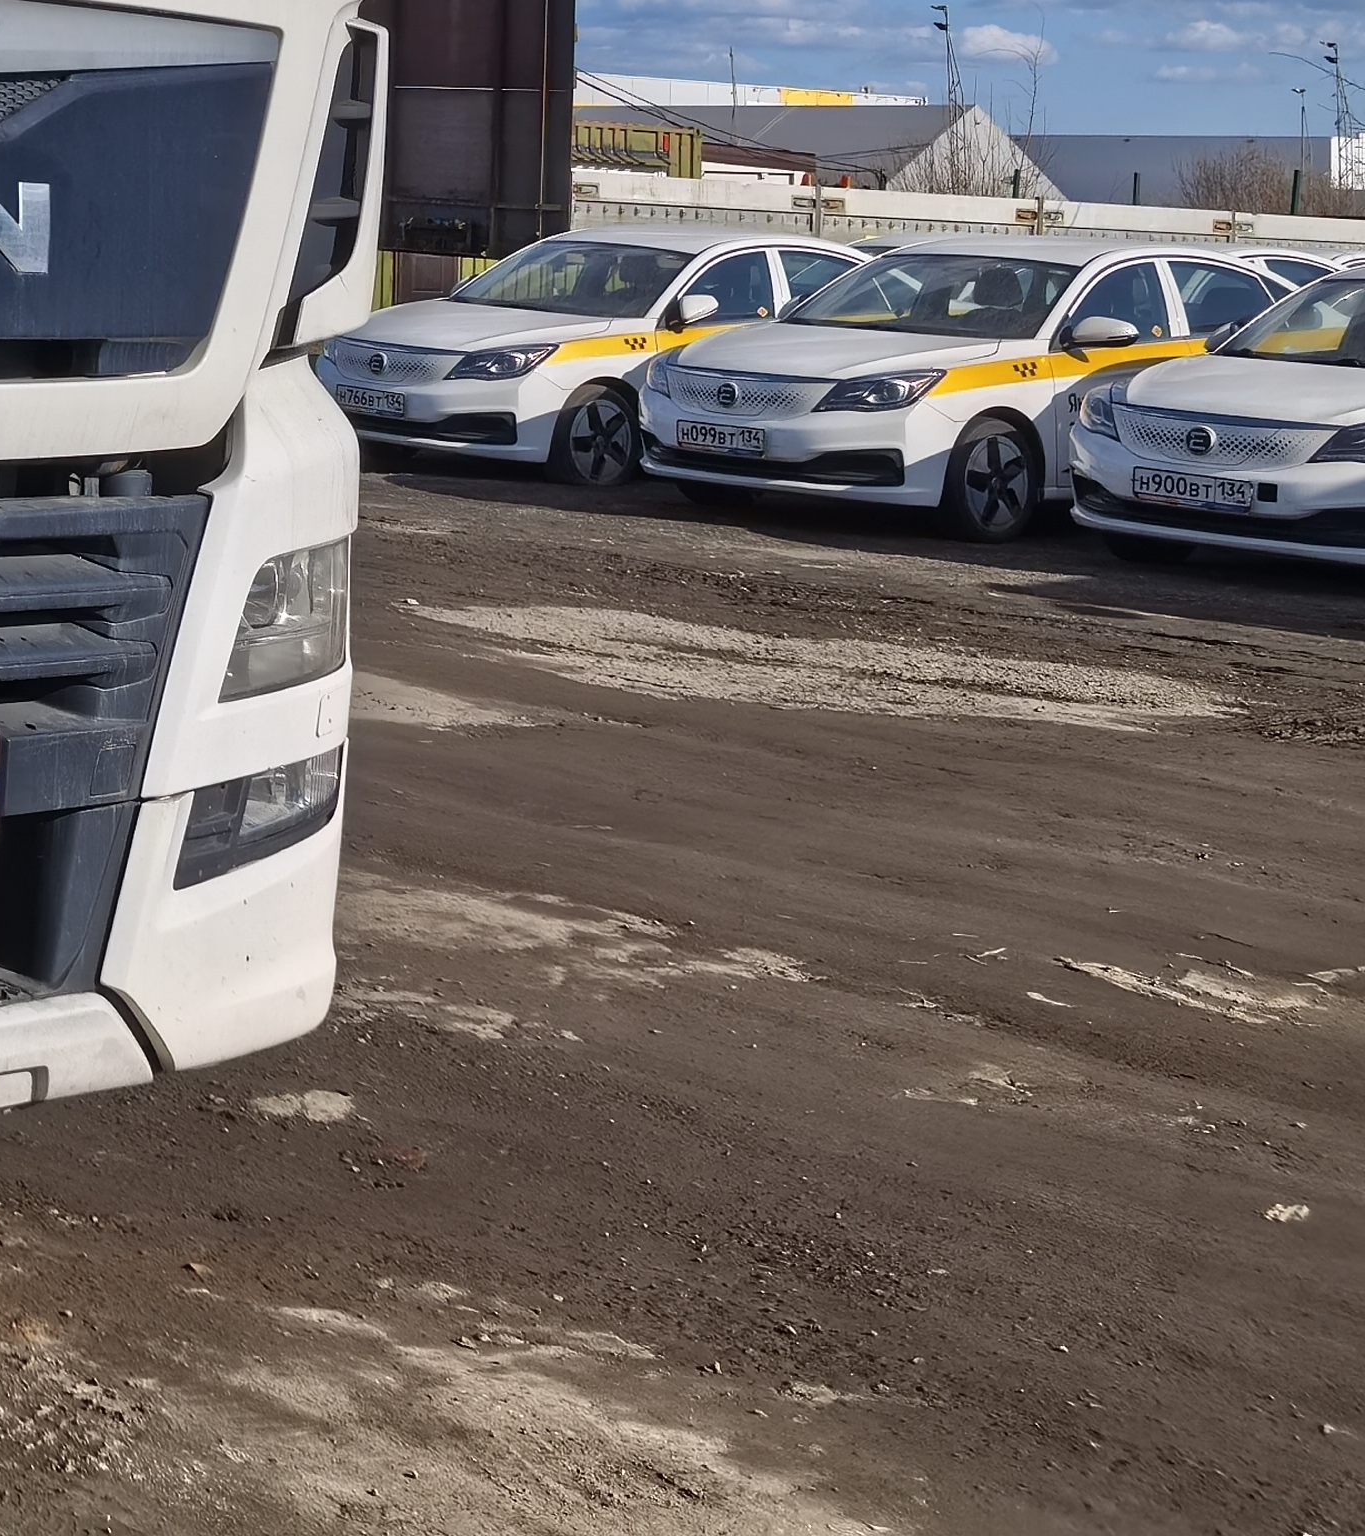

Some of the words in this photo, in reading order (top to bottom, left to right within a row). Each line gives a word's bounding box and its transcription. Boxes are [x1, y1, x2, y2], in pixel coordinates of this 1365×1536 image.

[384, 394, 402, 408] 134
[739, 429, 761, 444] 134
[1218, 480, 1246, 499] 134
